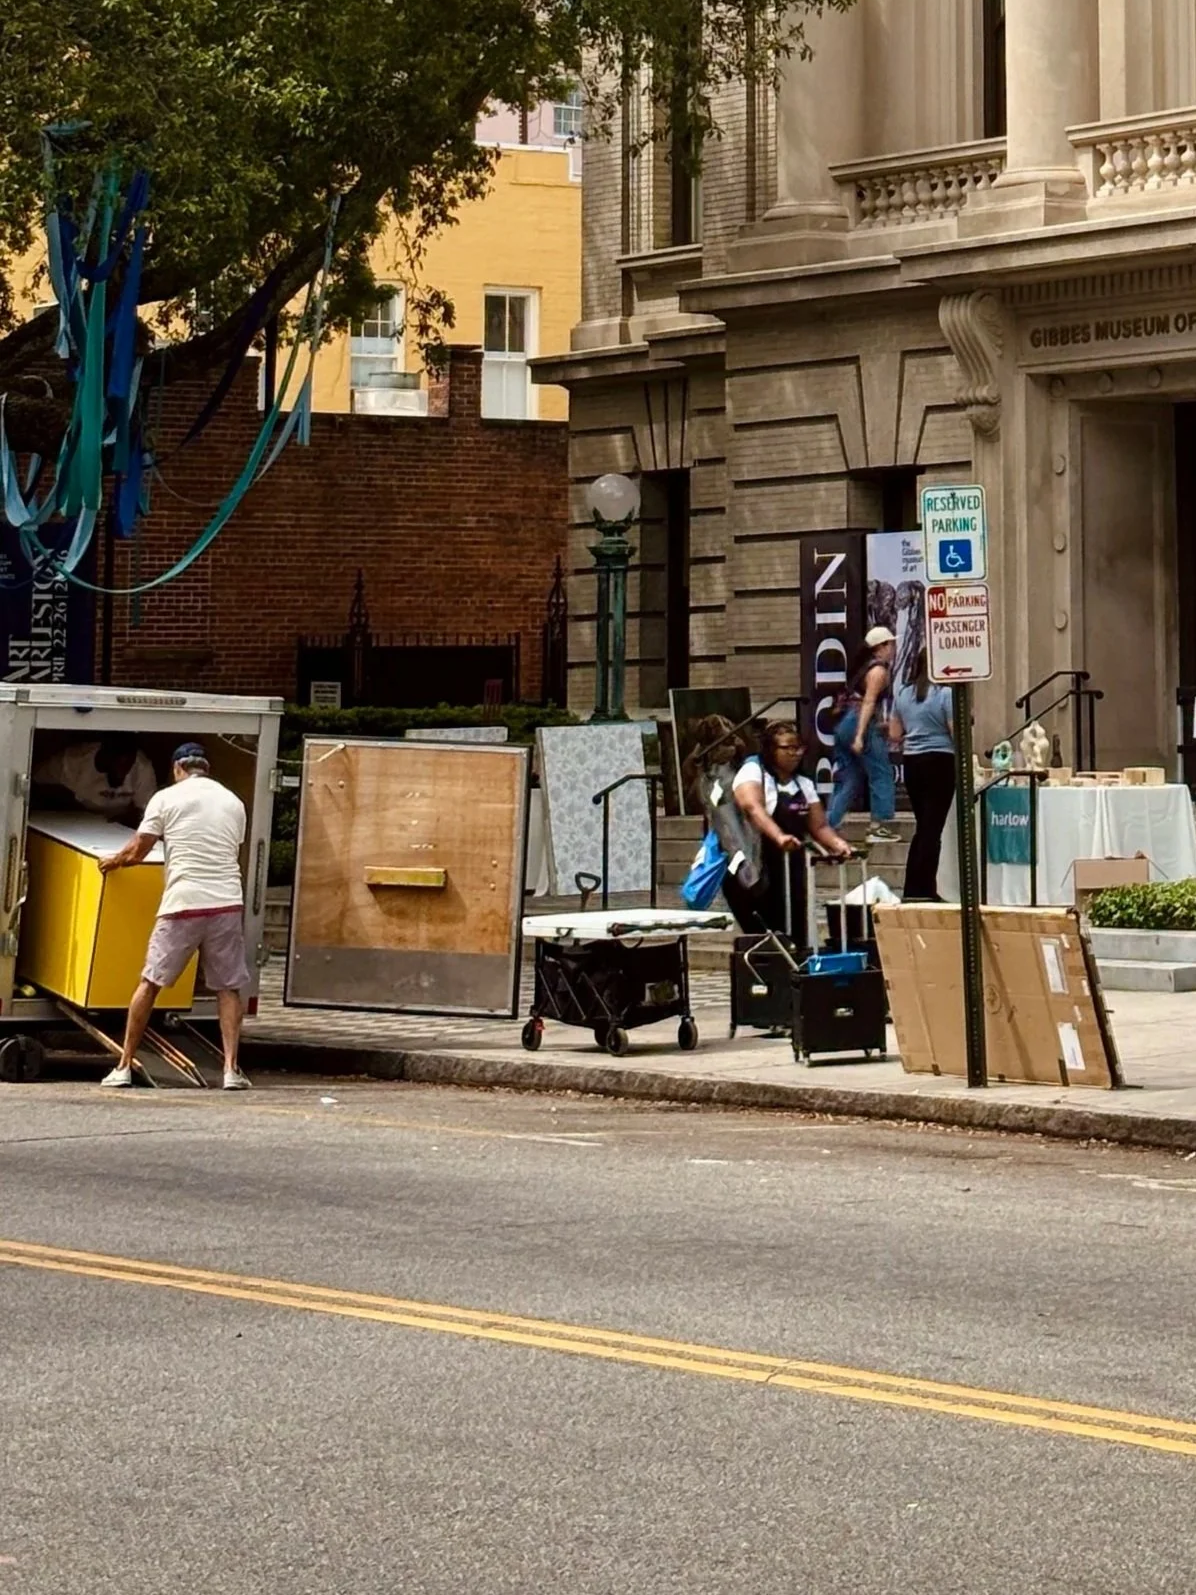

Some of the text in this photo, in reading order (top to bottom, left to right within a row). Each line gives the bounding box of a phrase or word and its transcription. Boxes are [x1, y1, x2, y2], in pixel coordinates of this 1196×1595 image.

[1030, 321, 1092, 349] GIBBES
[1094, 313, 1171, 342] MUSEUM
[926, 494, 981, 512] RESERVED
[931, 517, 978, 533] PARKING
[928, 592, 987, 612] NO PARKING
[933, 619, 986, 634] PASSENGER
[939, 635, 982, 650] LOADING
[991, 810, 1030, 826] harlow
